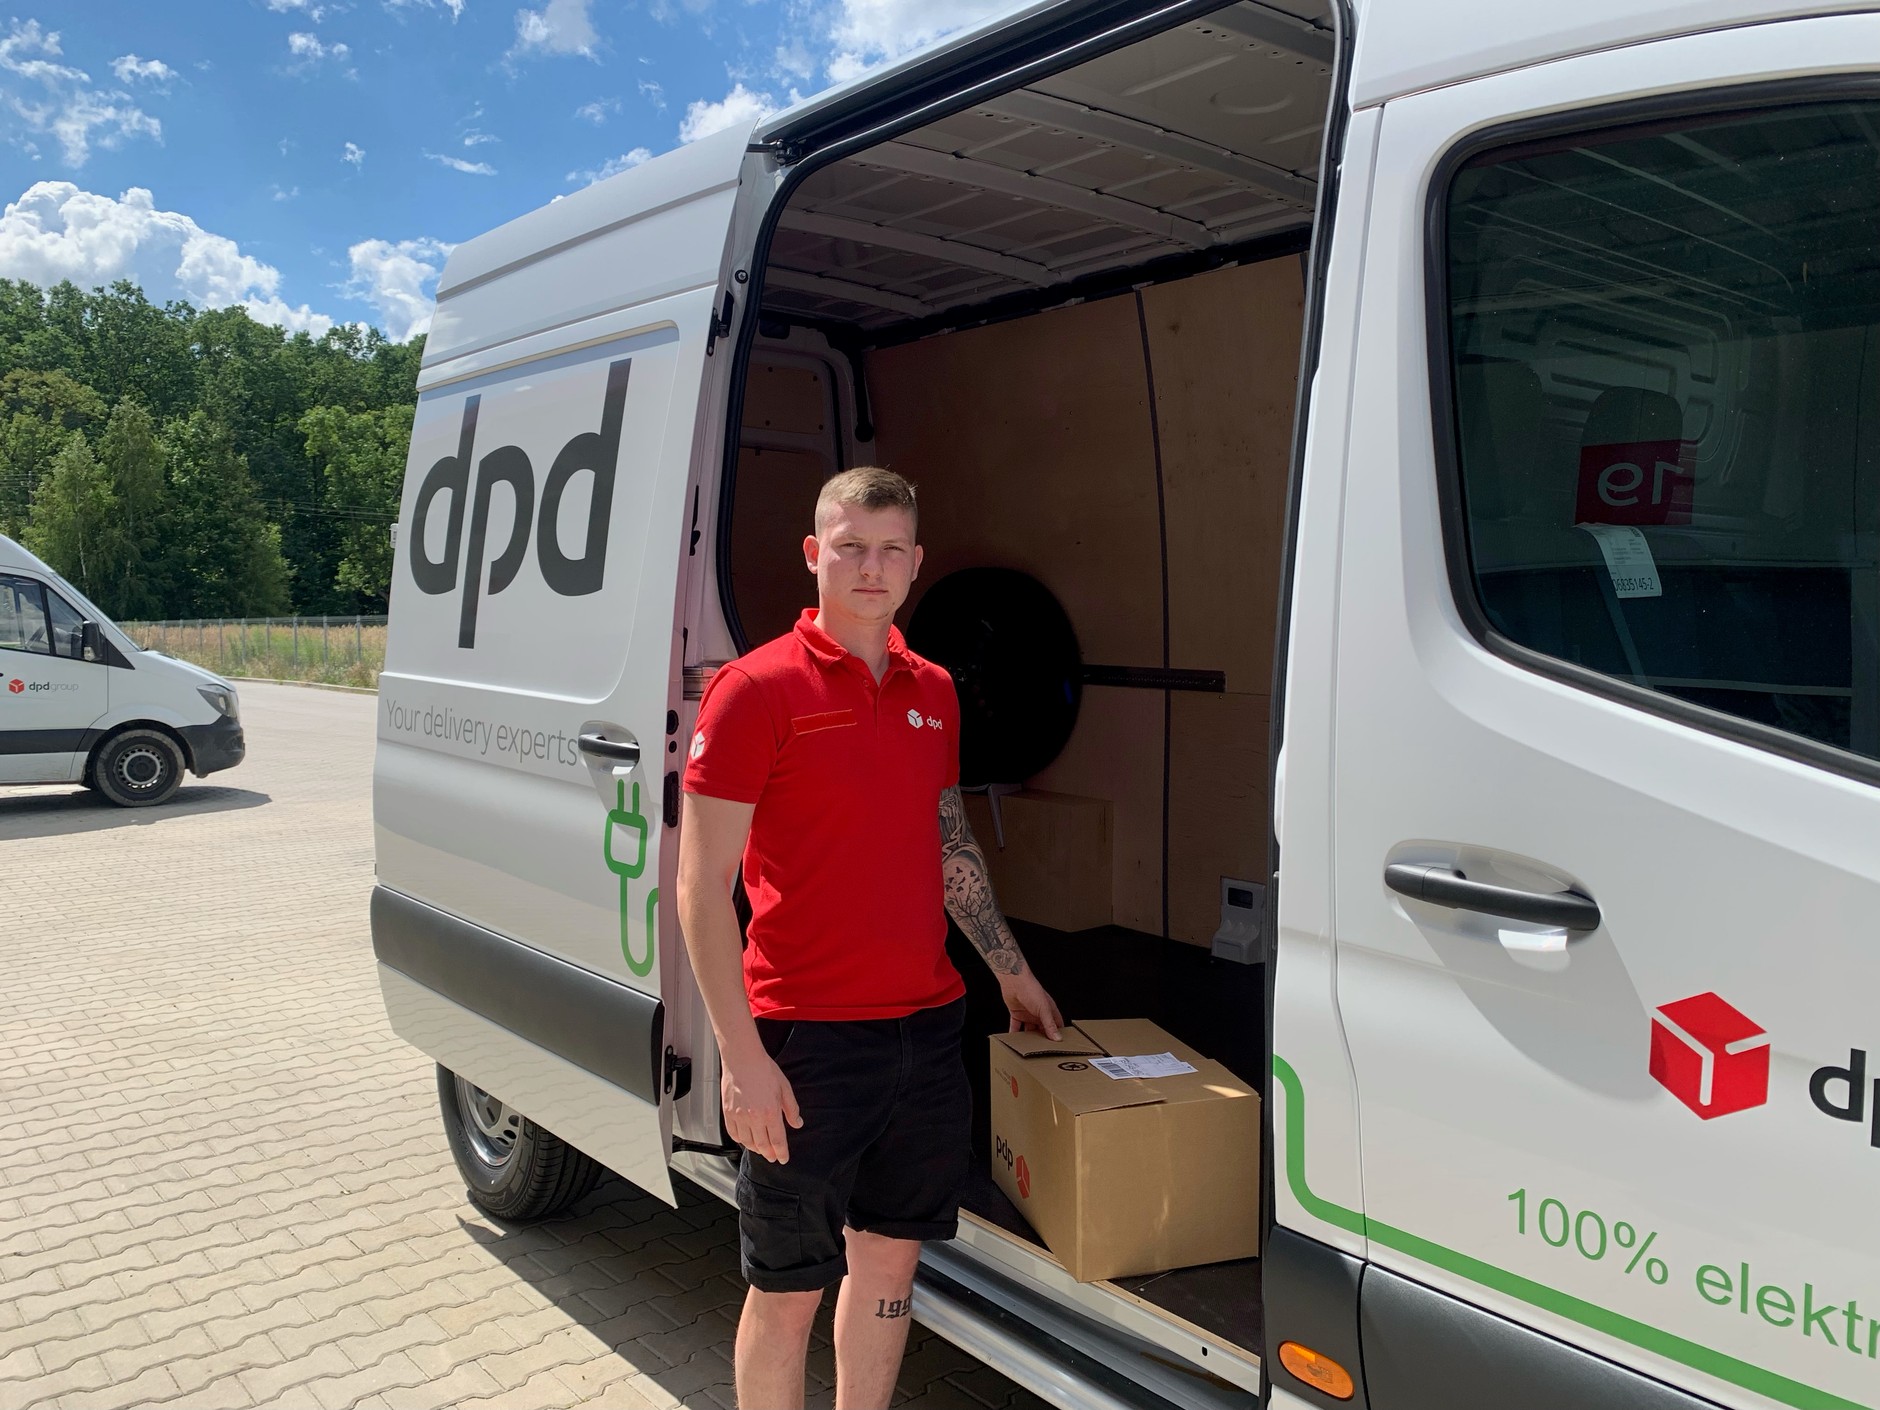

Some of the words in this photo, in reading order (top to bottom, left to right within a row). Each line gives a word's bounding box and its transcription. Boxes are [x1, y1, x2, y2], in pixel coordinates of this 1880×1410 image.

[409, 357, 632, 649] dpd
[386, 699, 421, 732] Your
[423, 705, 493, 755] delivery
[496, 724, 578, 767] experts
[926, 715, 943, 730] dpd
[1808, 1047, 1880, 1150] d
[996, 1134, 1014, 1172] dpd
[1507, 1187, 1669, 1285] 100%
